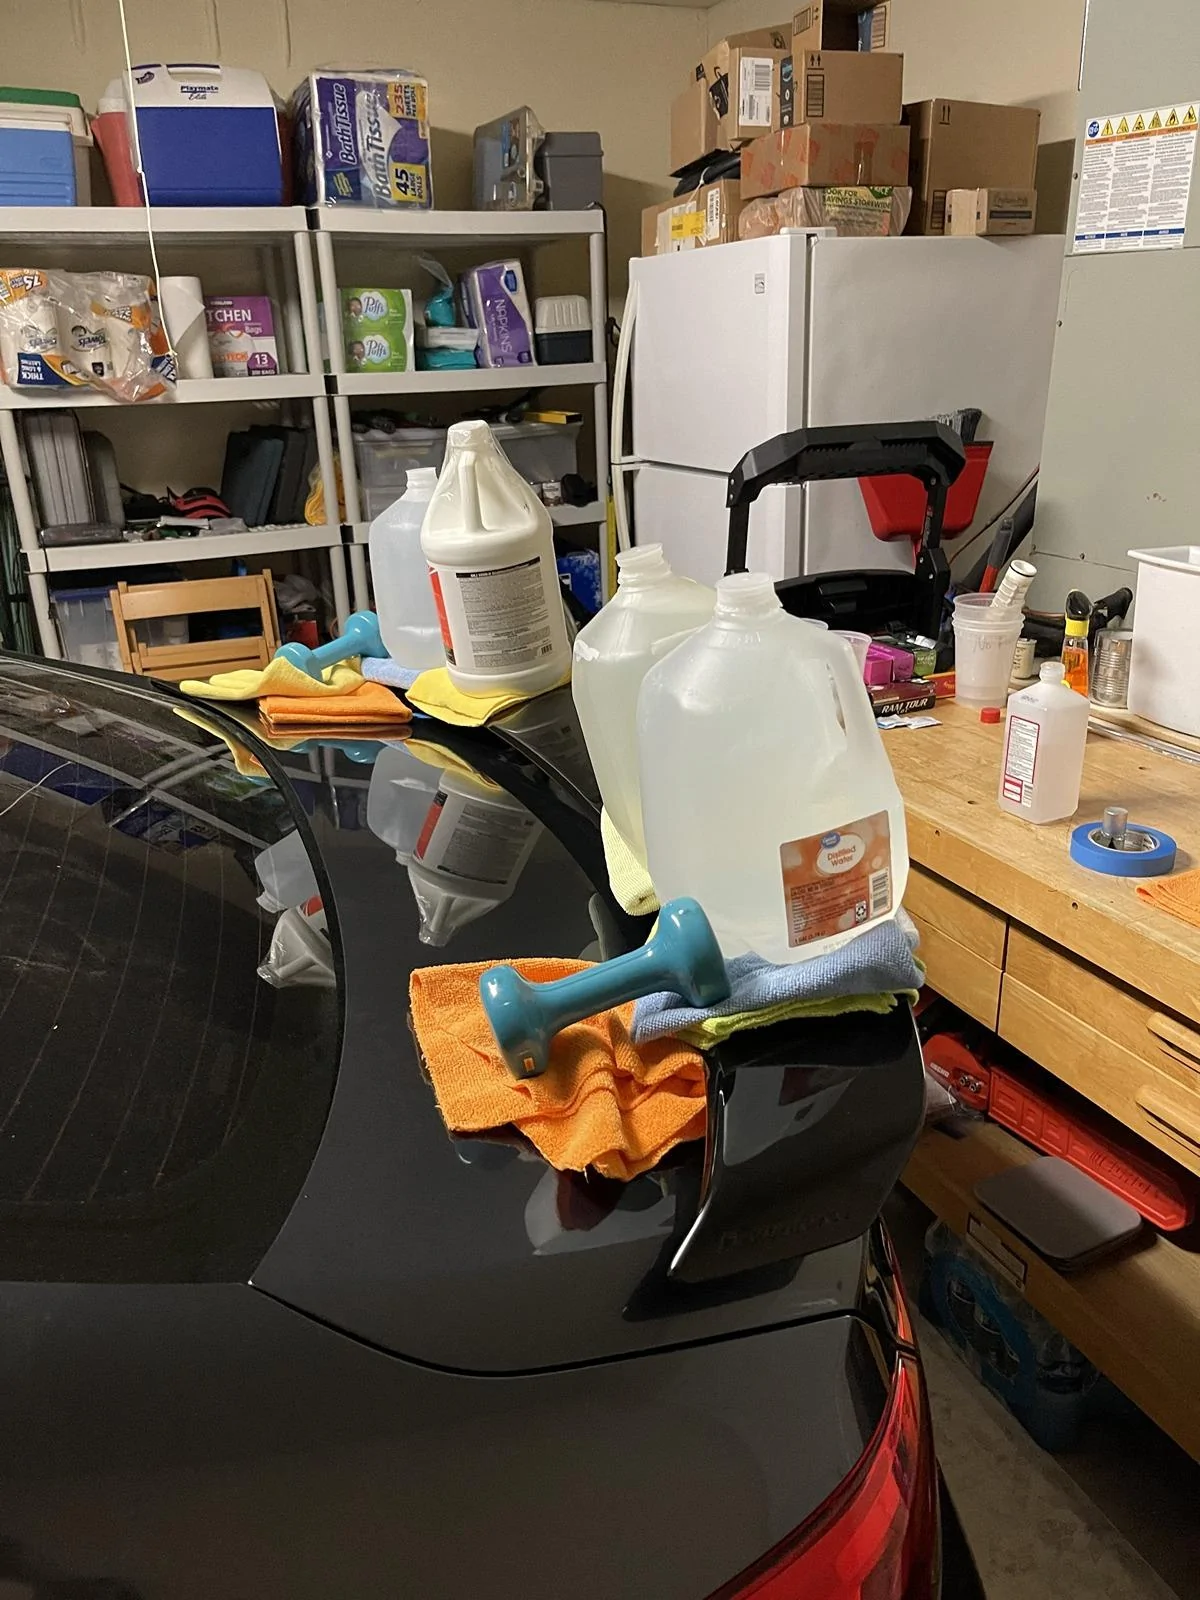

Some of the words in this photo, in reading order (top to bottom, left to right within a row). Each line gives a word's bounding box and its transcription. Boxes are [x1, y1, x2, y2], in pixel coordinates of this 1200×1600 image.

[181, 85, 219, 94] Playmate
[394, 84, 404, 114] 235
[395, 168, 409, 196] 45
[408, 173, 417, 197] LARGE
[364, 296, 385, 314] Puffs
[206, 309, 252, 322] TCHEN
[495, 299, 512, 353] NAPKINS
[366, 339, 387, 357] Puffs
[255, 354, 268, 365] 13
[22, 371, 44, 381] THICK
[882, 701, 903, 714] RAM
[905, 697, 928, 711] TOUR
[827, 845, 857, 861] Distilled
[831, 854, 854, 868] Water
